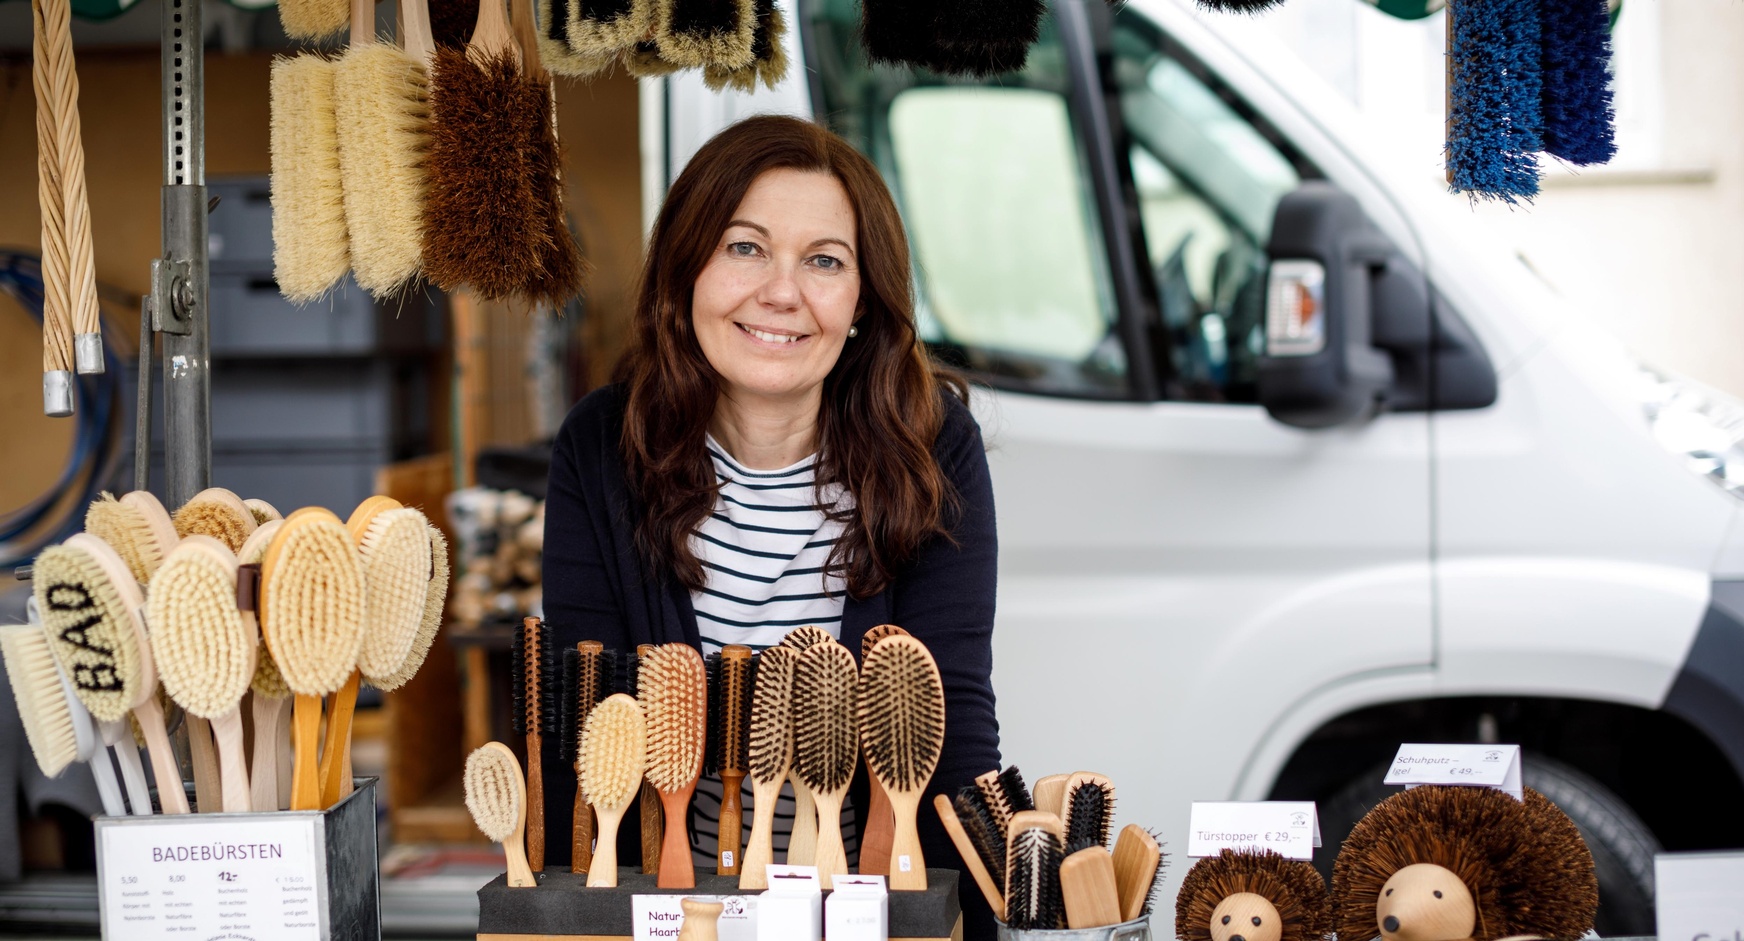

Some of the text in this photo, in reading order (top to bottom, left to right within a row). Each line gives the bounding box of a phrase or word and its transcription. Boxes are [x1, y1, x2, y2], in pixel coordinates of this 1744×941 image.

[46, 582, 124, 691] BAD
[1396, 756, 1450, 765] Schuhputz
[1392, 767, 1411, 776] Igel
[1450, 767, 1457, 775] €
[1197, 830, 1258, 843] Türstopper
[1264, 831, 1272, 842] €
[152, 842, 282, 862] BADEBÜRSTEN
[121, 876, 138, 885] 5,50
[168, 874, 186, 883] 8,00
[648, 911, 685, 921] Natur-
